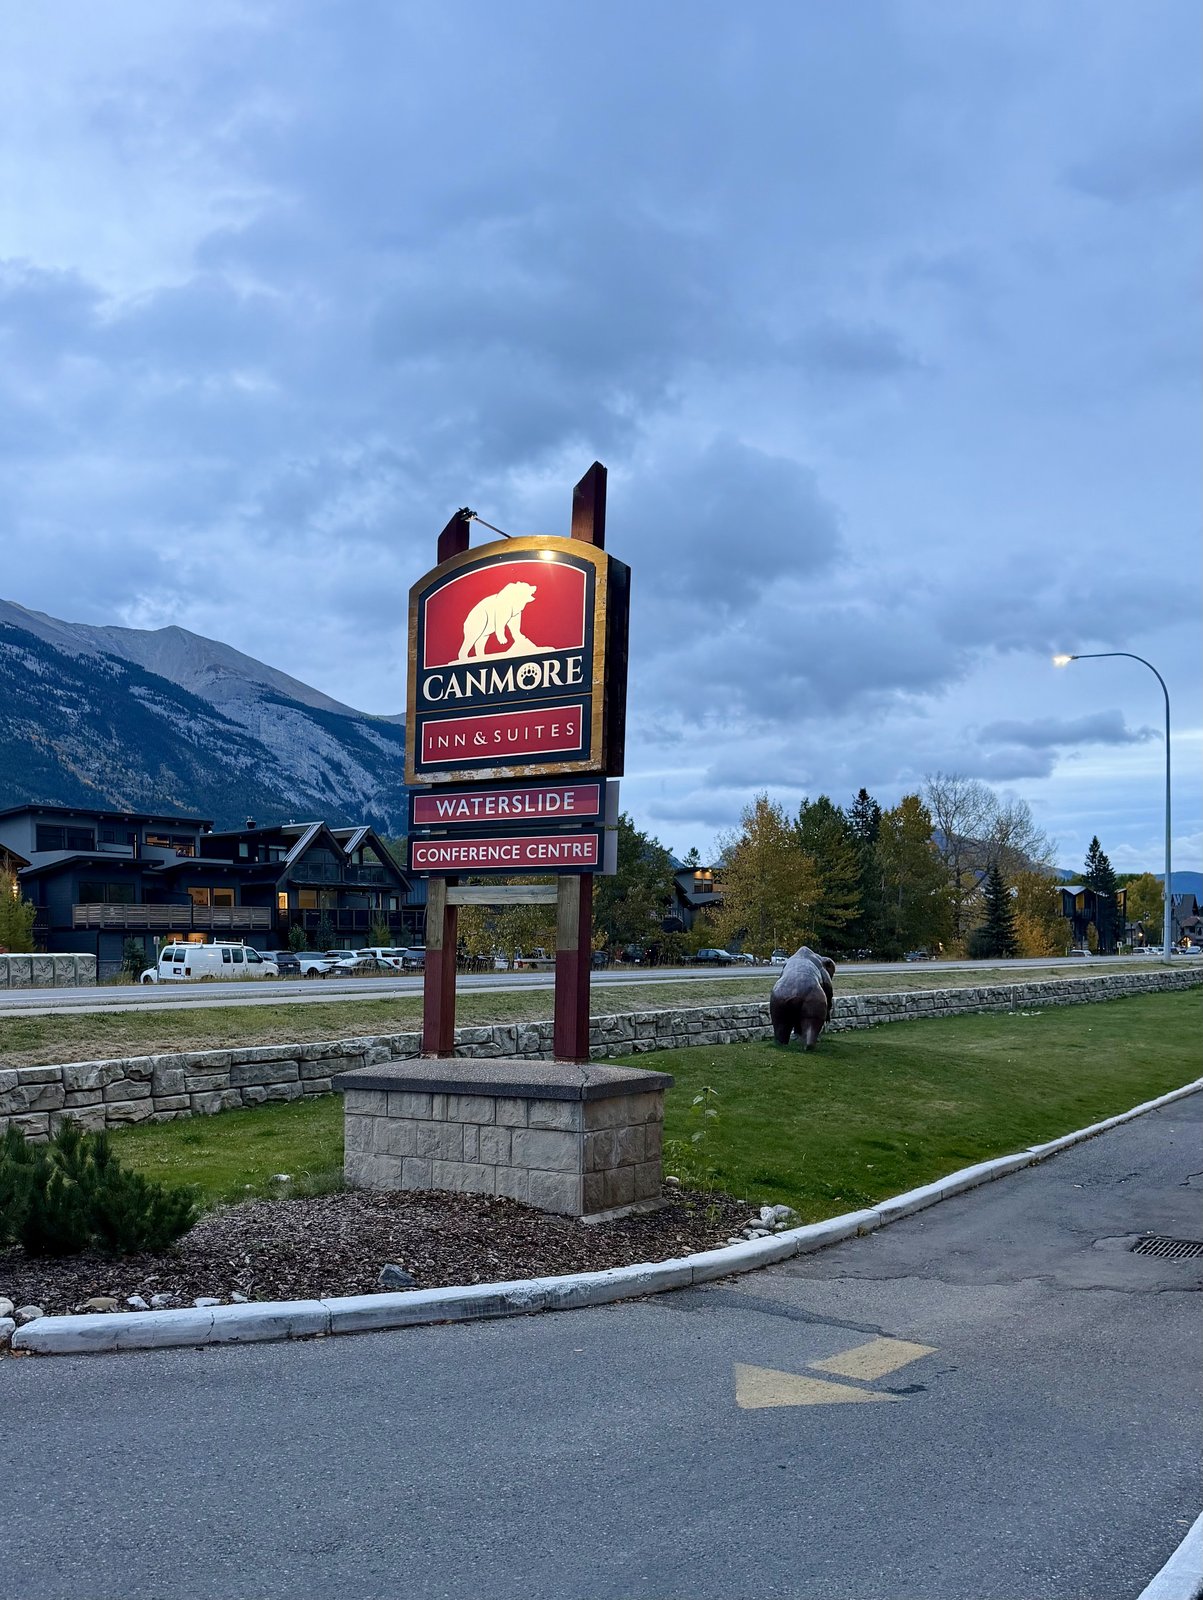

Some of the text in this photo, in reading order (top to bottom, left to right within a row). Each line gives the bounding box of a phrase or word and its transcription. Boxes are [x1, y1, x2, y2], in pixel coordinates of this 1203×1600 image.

[423, 656, 583, 701] CANMORE
[429, 722, 575, 749] INN & SUITES
[436, 792, 575, 817] WATERSLIDE
[416, 842, 592, 862] CONFERENCE CENTRE
